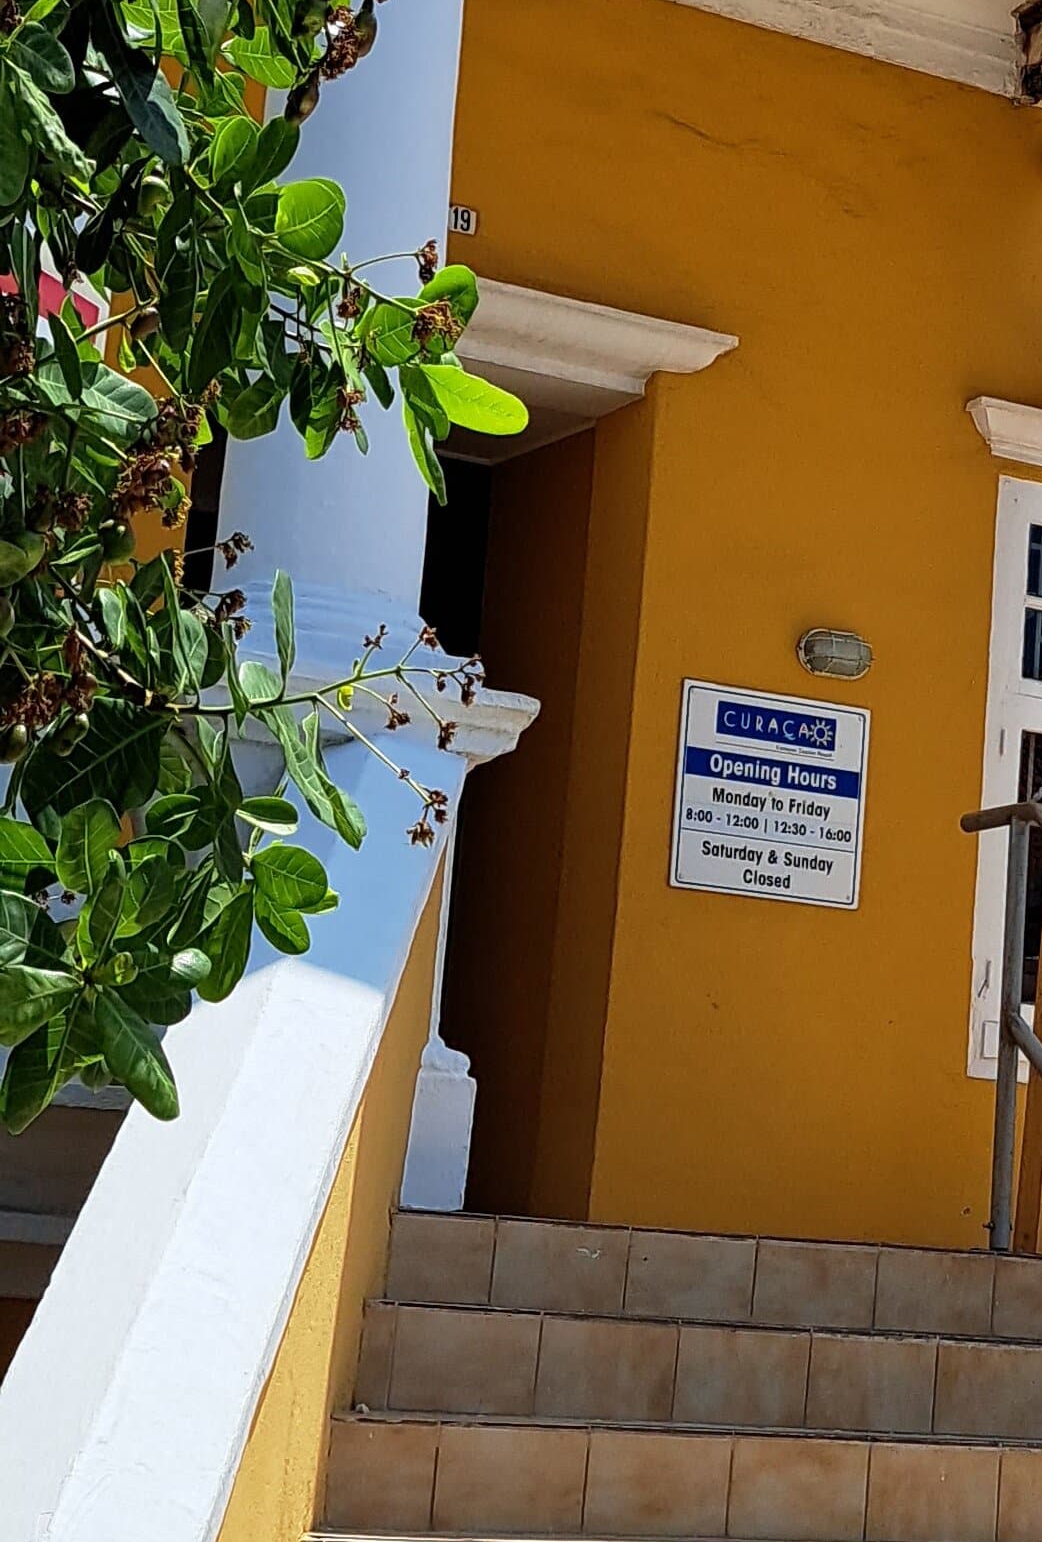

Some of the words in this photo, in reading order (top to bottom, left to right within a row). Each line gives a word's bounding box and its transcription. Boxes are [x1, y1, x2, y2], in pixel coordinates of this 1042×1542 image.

[453, 207, 471, 231] 19
[709, 753, 781, 785] Opening
[787, 764, 837, 790] Hours
[712, 787, 767, 812] Monday
[771, 795, 784, 812] to
[788, 798, 831, 821] Friday
[686, 808, 713, 823] 8:00
[726, 813, 759, 830] 12:00
[774, 820, 807, 836] 12:30
[819, 826, 852, 843] 16:00
[701, 840, 764, 867] Saturday
[768, 849, 778, 864] &
[783, 851, 834, 876] Sunday
[743, 868, 791, 889] Closed
